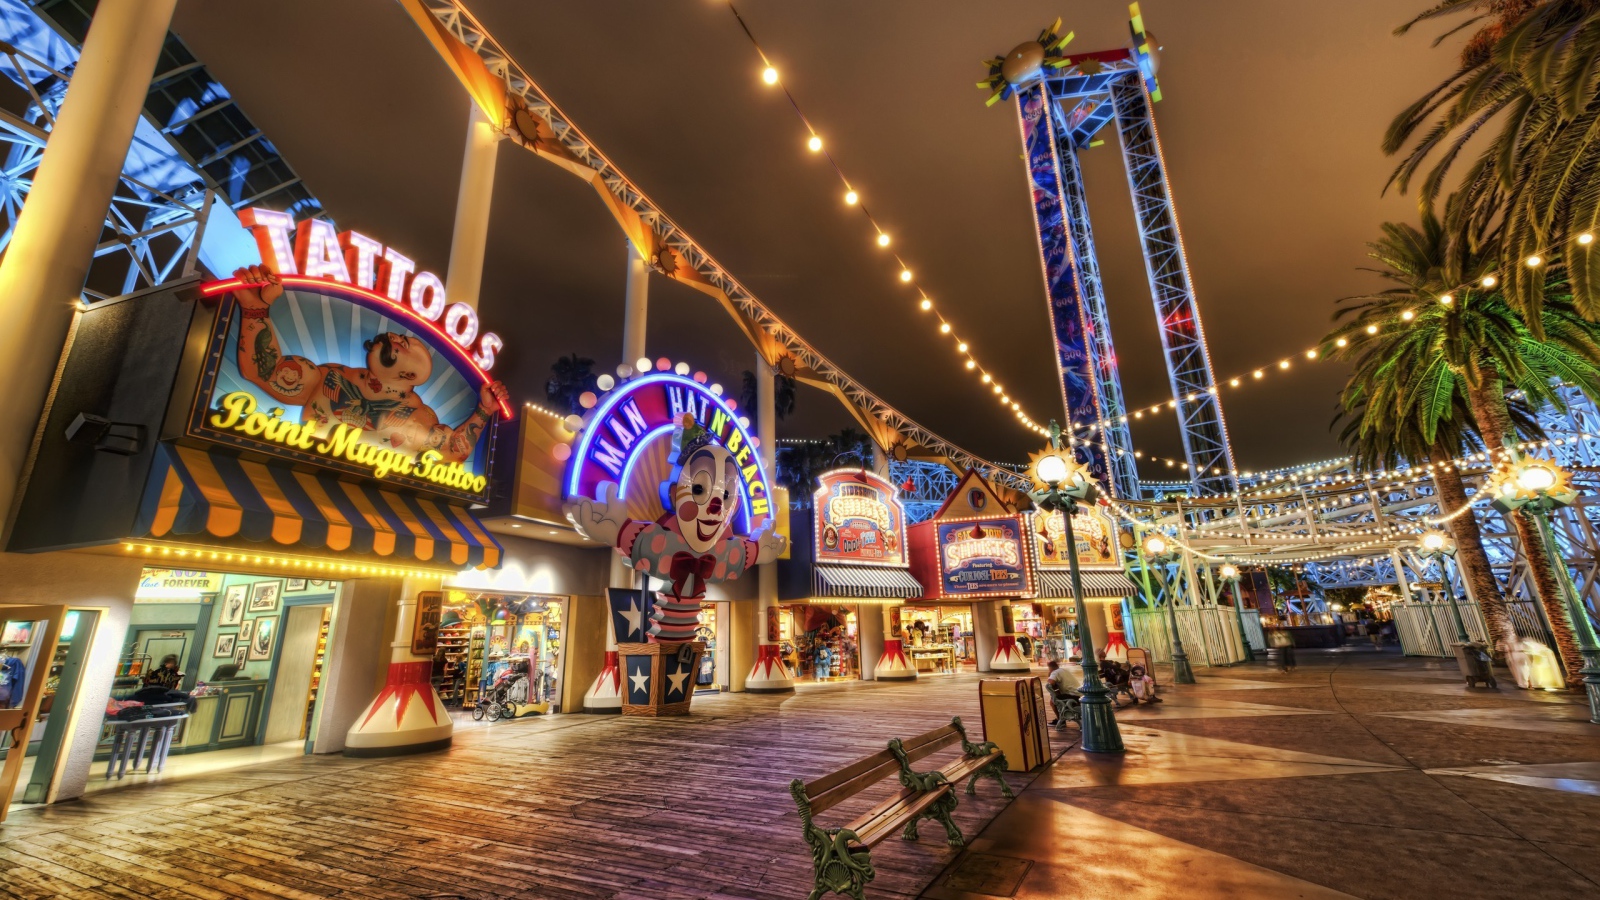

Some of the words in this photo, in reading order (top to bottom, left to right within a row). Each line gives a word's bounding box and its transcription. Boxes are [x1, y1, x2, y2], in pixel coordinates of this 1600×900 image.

[1032, 152, 1050, 165] 900
[1040, 198, 1056, 210] 800
[240, 207, 504, 371] TATTOOS
[1056, 296, 1073, 307] 600
[1064, 349, 1082, 361] 500
[1073, 404, 1092, 416] 400
[210, 391, 317, 449] Point
[317, 422, 413, 479] Mugu
[413, 449, 488, 493] Tattoo
[592, 398, 648, 476] MAN
[668, 385, 710, 424] HAT
[727, 427, 769, 516] BEACH
[841, 485, 878, 501] SIDESHOW
[947, 540, 1018, 569] SHIRTS
[163, 579, 210, 588] FOREVER
